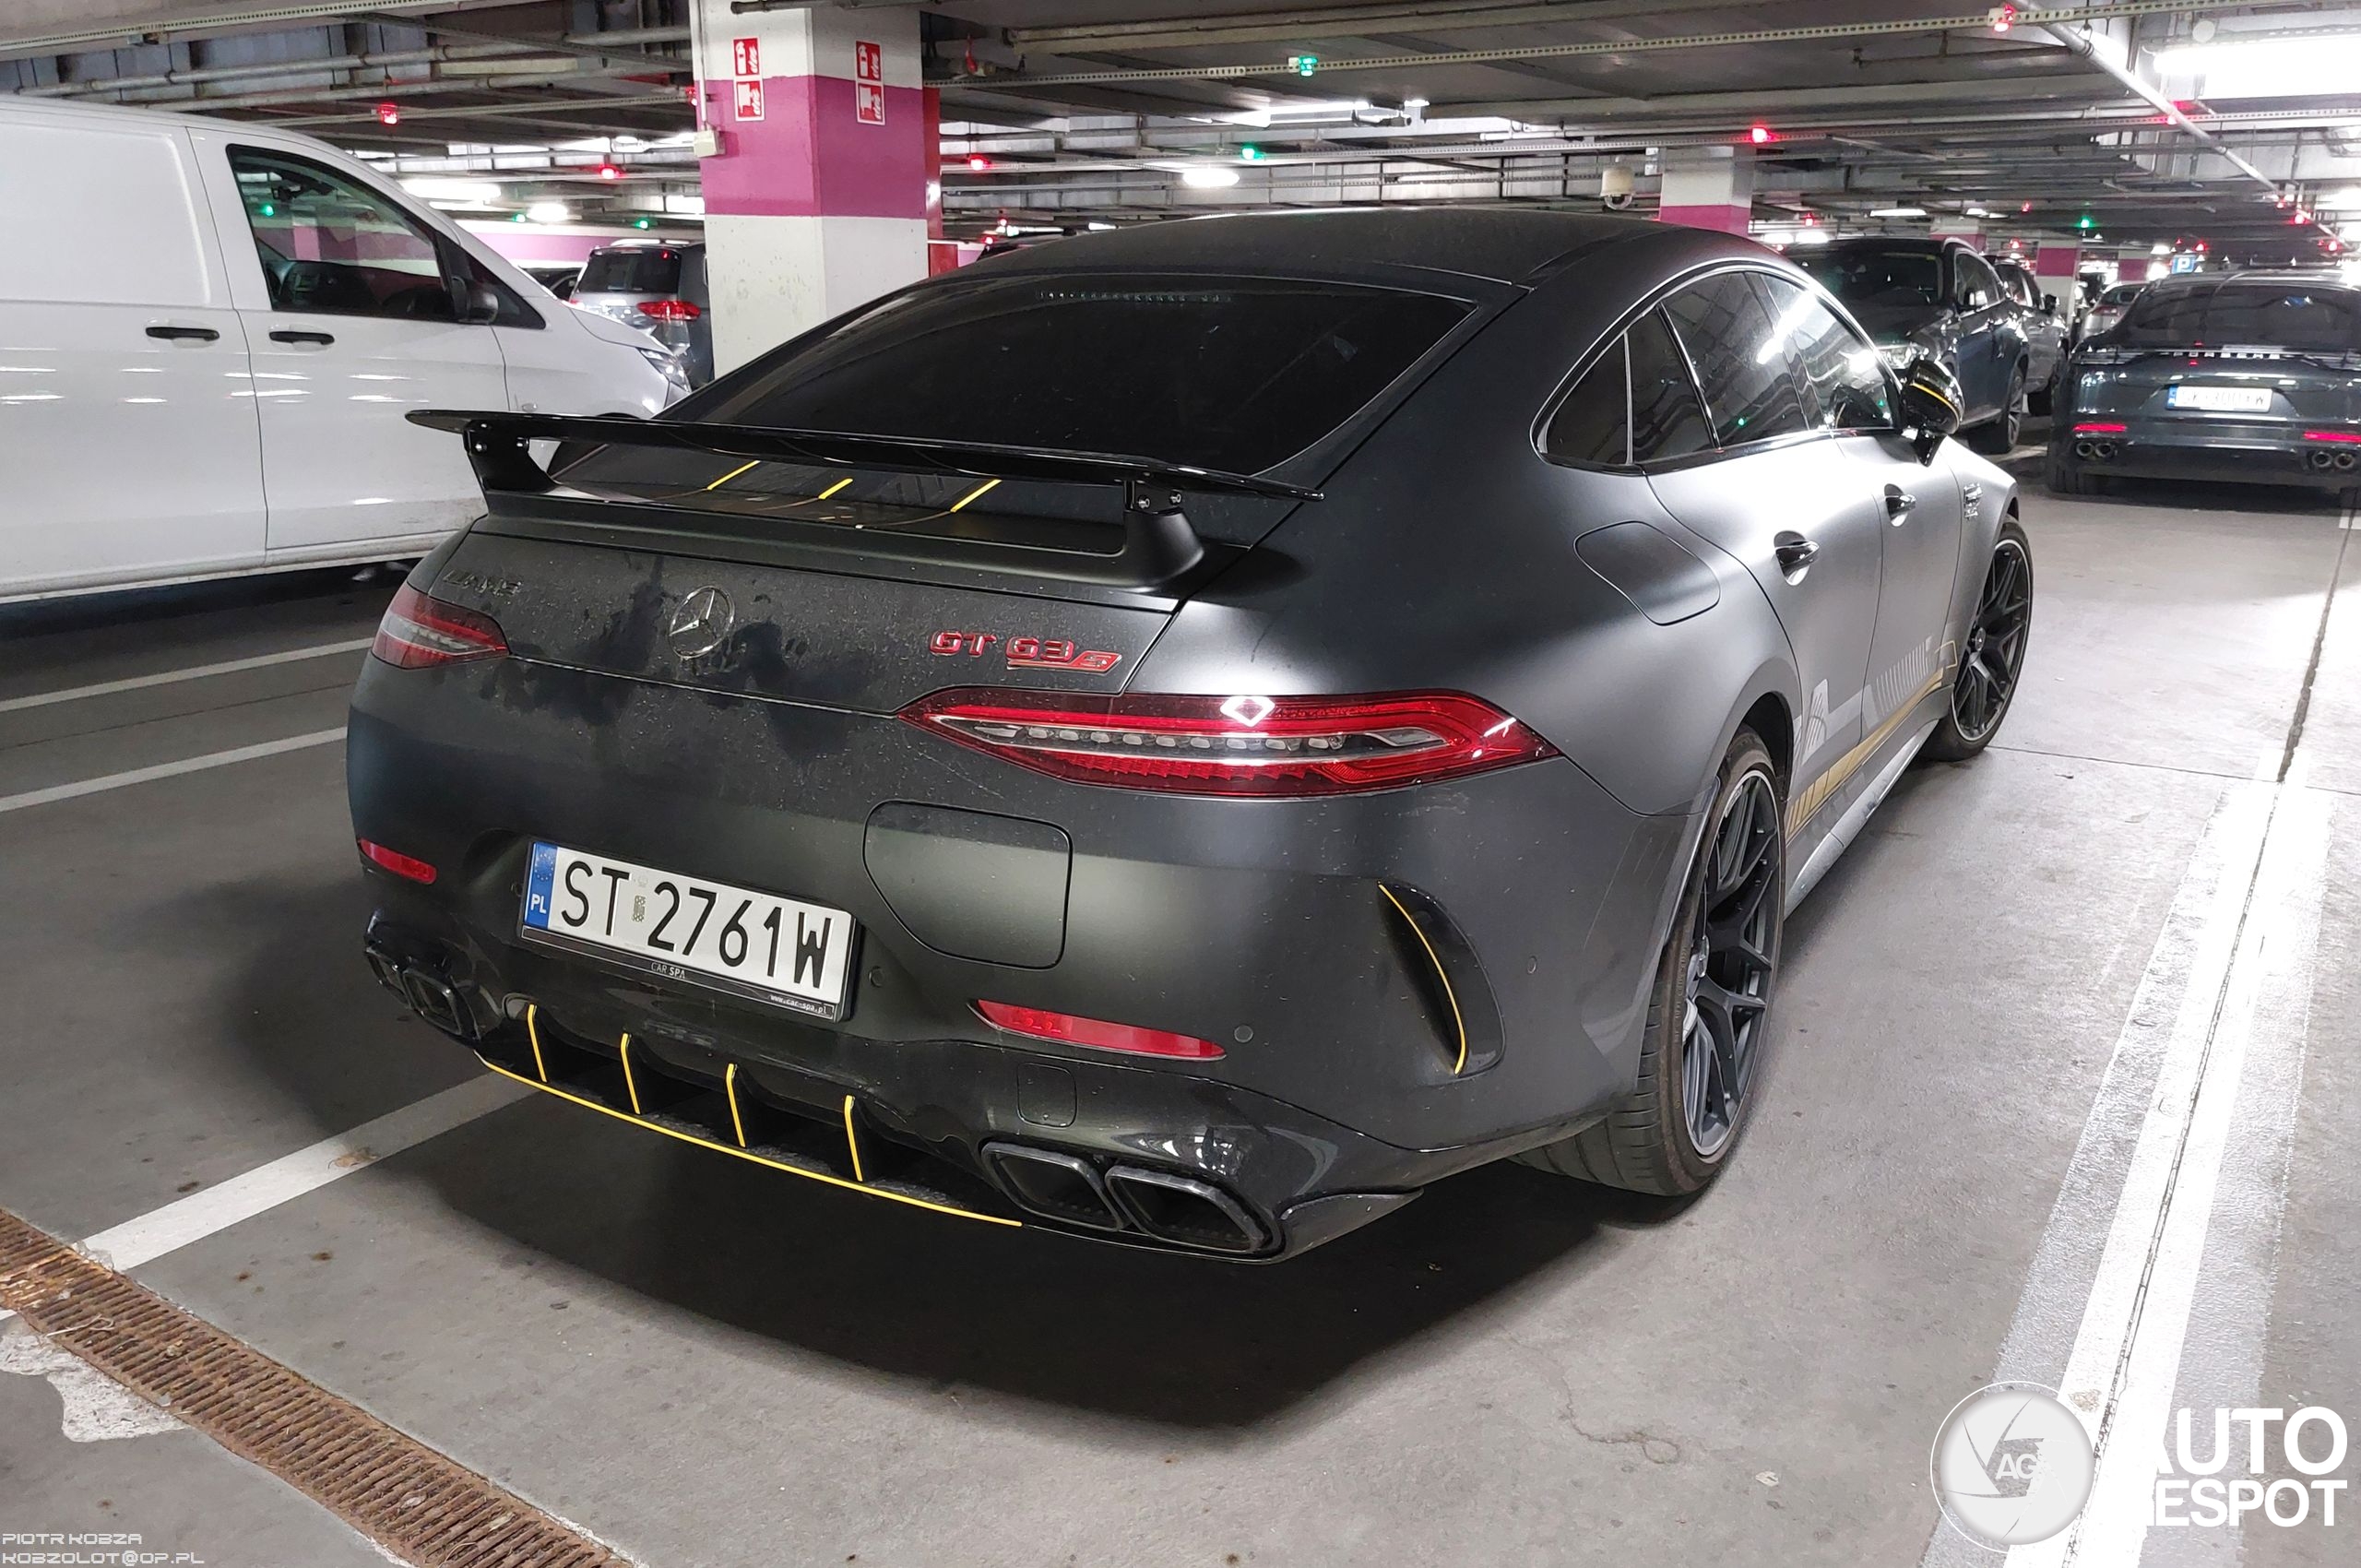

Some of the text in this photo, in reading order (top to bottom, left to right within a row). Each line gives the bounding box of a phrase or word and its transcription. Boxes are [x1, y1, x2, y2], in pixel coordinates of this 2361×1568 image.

[930, 630, 997, 658] GT
[1005, 636, 1074, 662] 63
[530, 893, 547, 914] PL
[561, 860, 833, 989] ST 2761W
[650, 962, 686, 980] CAR SPA
